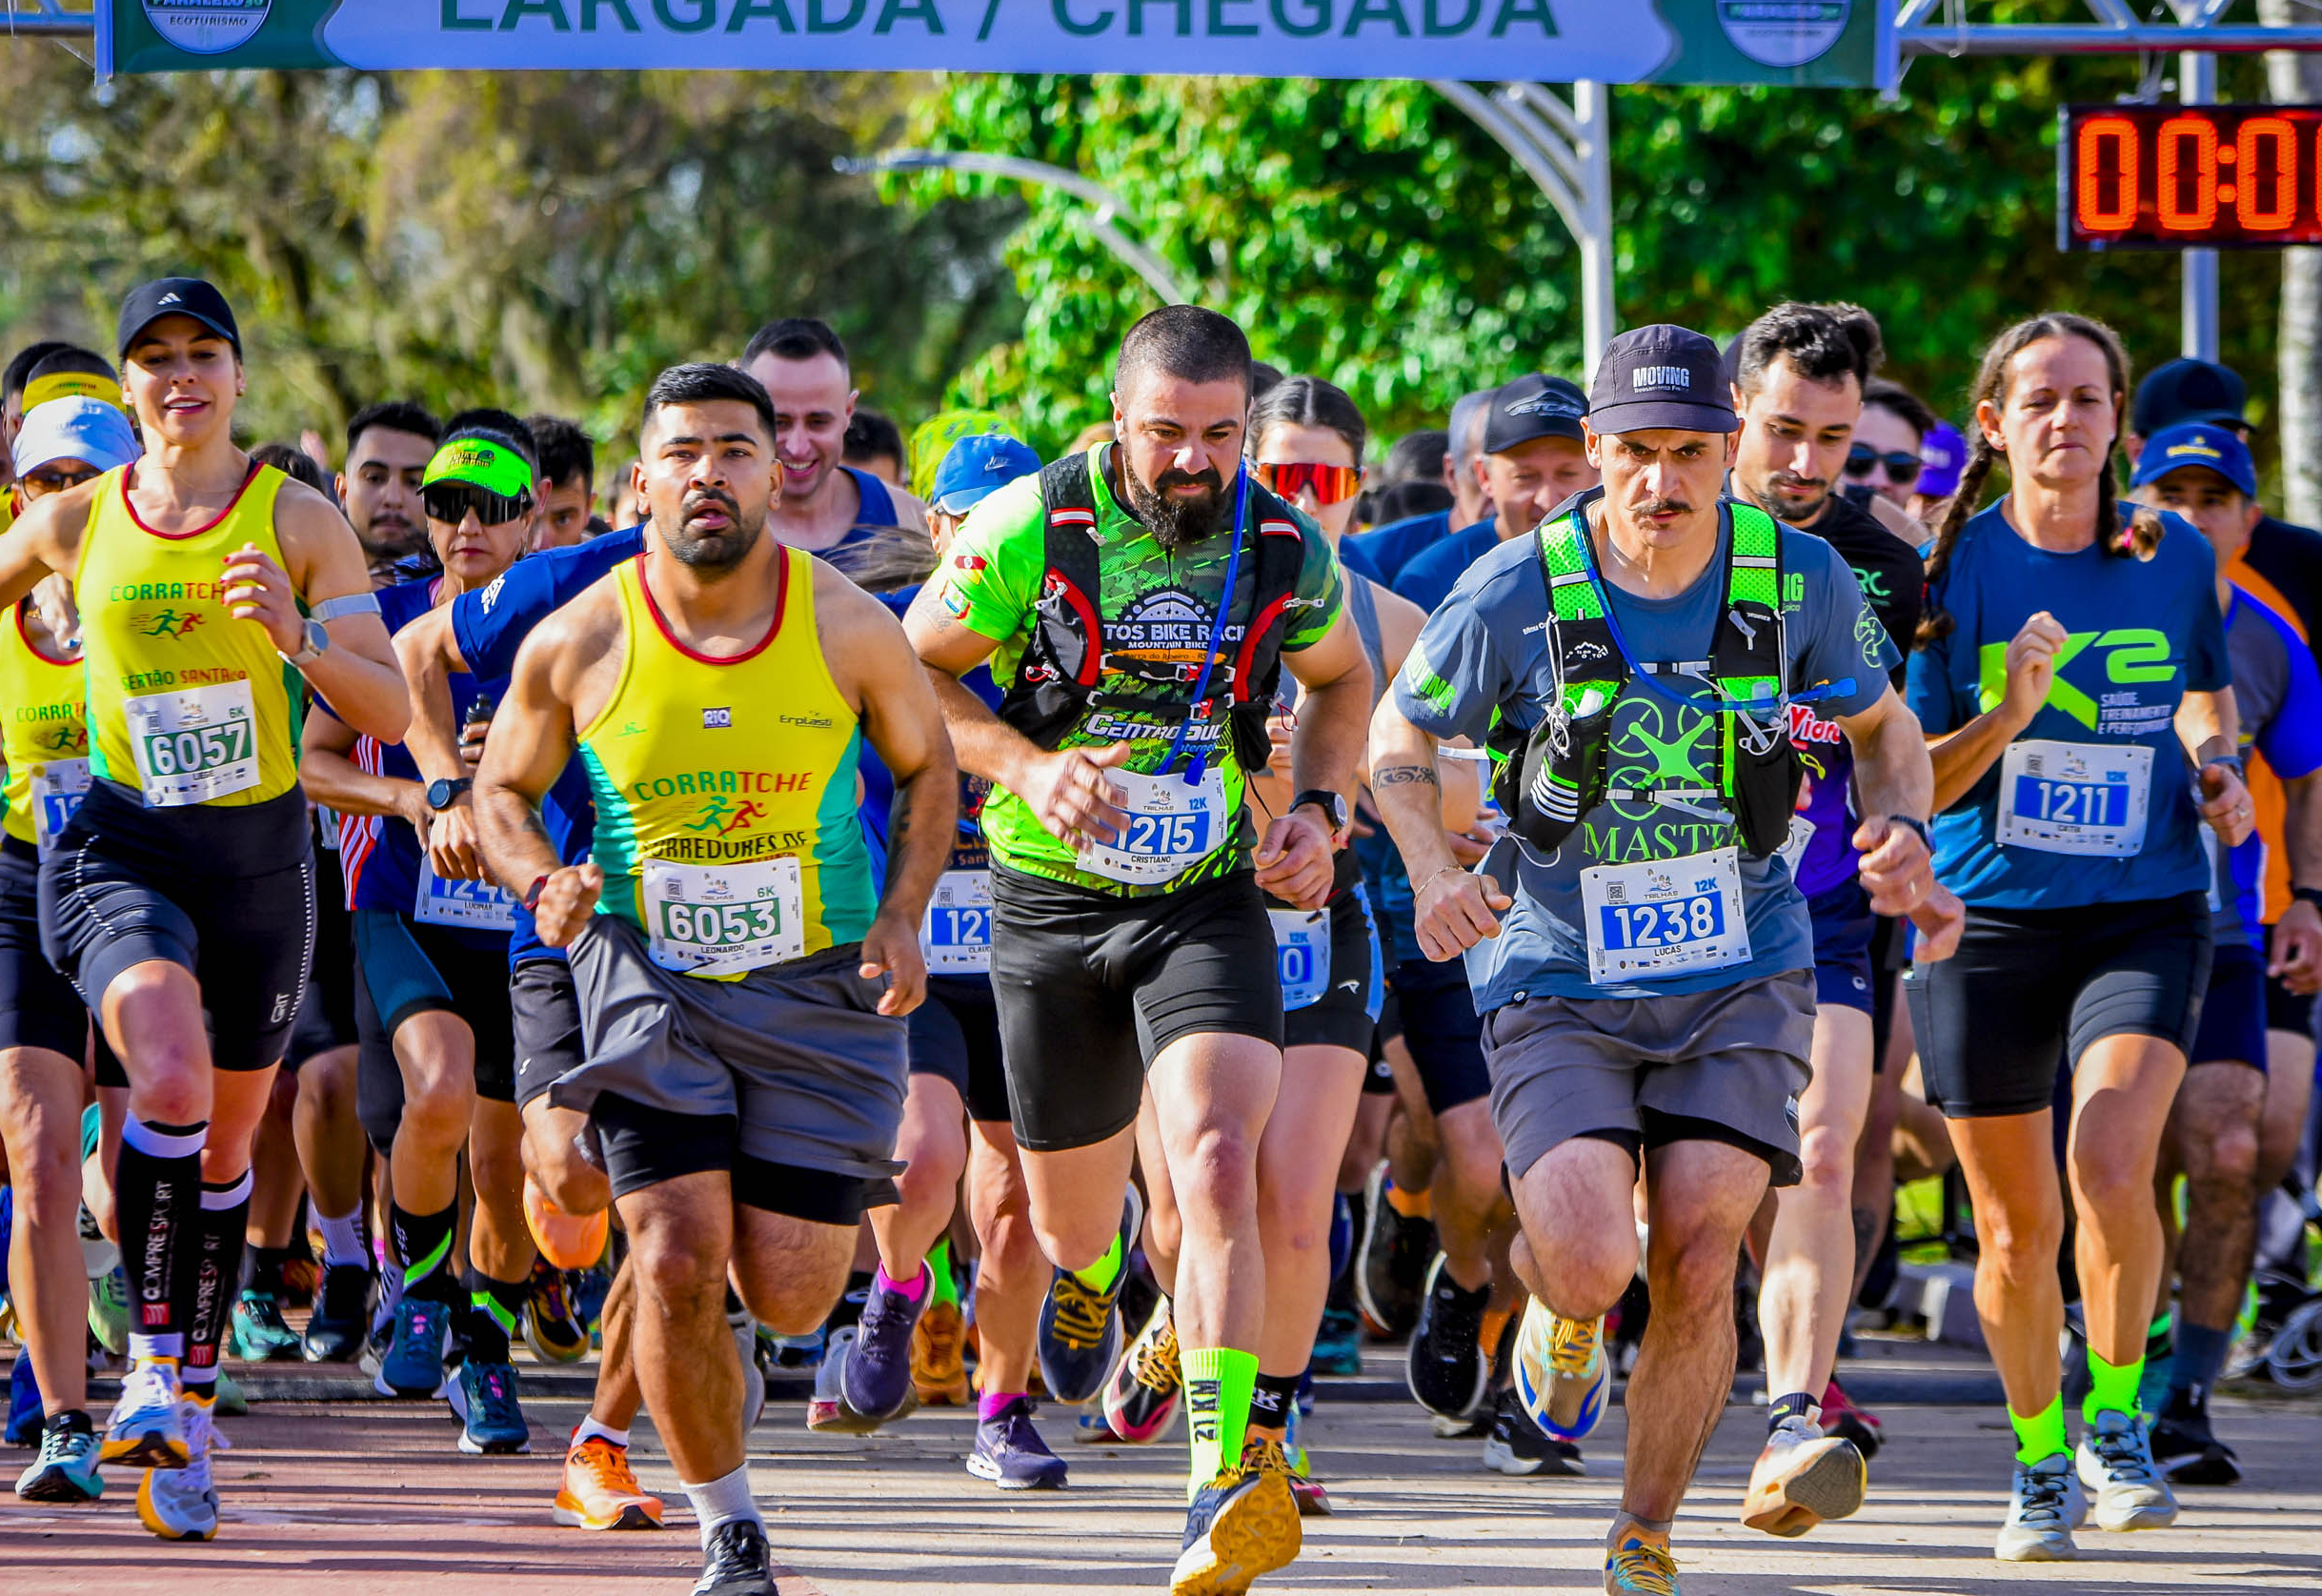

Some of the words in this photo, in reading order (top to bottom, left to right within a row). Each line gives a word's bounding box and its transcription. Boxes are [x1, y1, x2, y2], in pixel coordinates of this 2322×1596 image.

[170, 17, 248, 26] ECOTURISMO
[2078, 117, 2322, 231] 00:0
[1633, 366, 1690, 388] MOVING
[1150, 625, 1191, 641] BIKE
[151, 721, 248, 776] 6057
[634, 770, 812, 801] CORRATCHE
[1189, 797, 1208, 810] 12K
[2038, 781, 2110, 825] 1211
[1117, 815, 1197, 855] 1215
[1131, 855, 1172, 865] CRISTIANO
[757, 886, 776, 899] 6K
[1694, 878, 1718, 894] 12K
[1644, 891, 1679, 900] TRILHAS
[667, 899, 777, 945] 6053
[1614, 897, 1714, 949] 1238
[700, 943, 745, 955] LEONARDO
[1654, 945, 1682, 957] LUCAS
